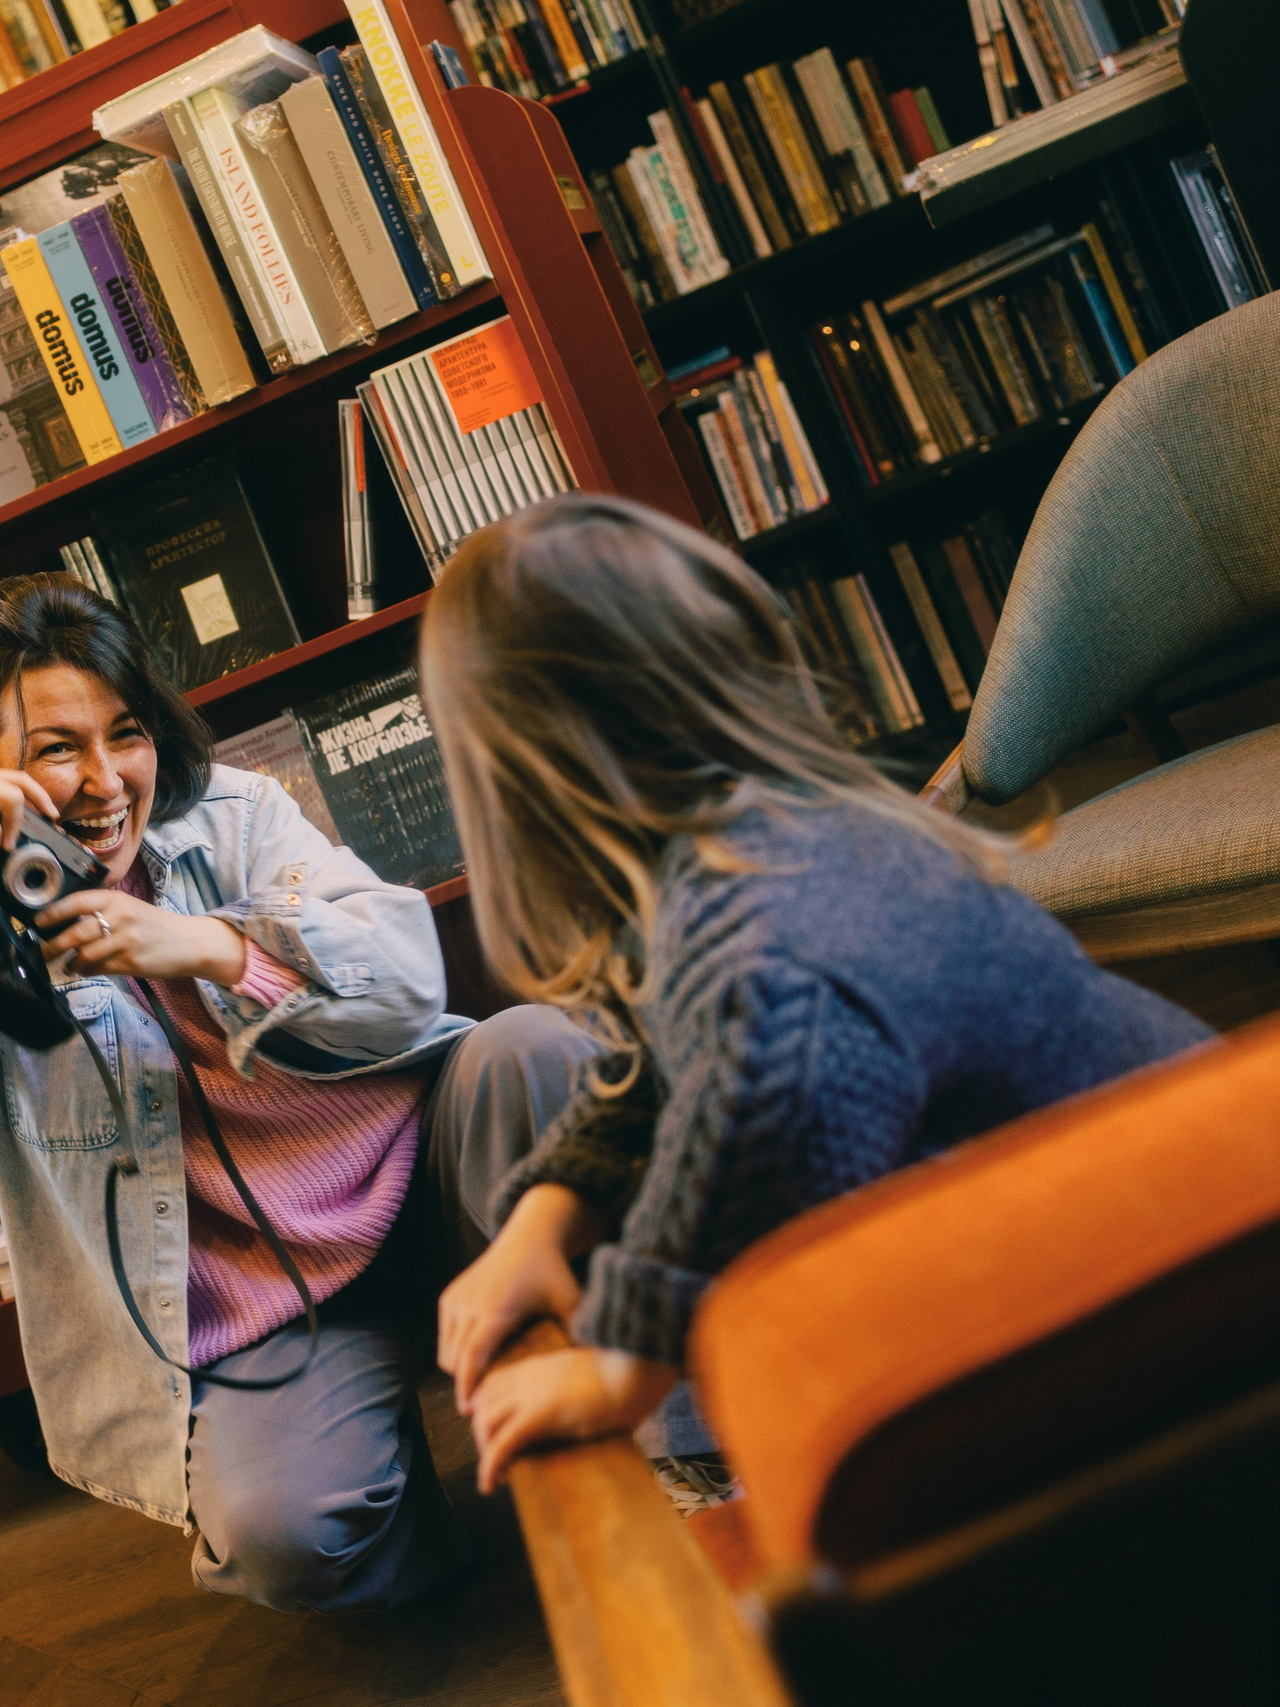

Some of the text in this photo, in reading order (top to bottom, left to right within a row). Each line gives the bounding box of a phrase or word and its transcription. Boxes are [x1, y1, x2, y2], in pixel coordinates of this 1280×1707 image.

[353, 5, 417, 121] KNOKKE
[185, 146, 201, 163] THE
[331, 73, 348, 101] BLUE
[345, 105, 359, 127] AND
[356, 131, 375, 165] WHITE
[385, 203, 405, 237] RIGHT
[380, 127, 405, 164] Design
[401, 121, 425, 149] LE
[191, 160, 210, 183] EDITH
[411, 149, 451, 214] ZOUTE
[199, 180, 228, 226] FARNSWORTH
[324, 149, 376, 255] CONTEMPORARY LIVING
[217, 146, 296, 305] ISLAND FOLLIES
[217, 223, 237, 248] HOUSE
[68, 290, 123, 382] domus
[104, 271, 160, 365] domus
[34, 306, 88, 397] domus
[437, 342, 487, 368] АРХИТЕКТУРА
[441, 353, 488, 378] СОВЕТСКОГО
[446, 361, 497, 389] МОДЕРНИЗМА
[144, 517, 221, 557] ПРОФЕССИЯ
[147, 529, 228, 571] АРХИТЕКТОР
[316, 713, 375, 754] ЖИЗНЬ
[324, 747, 350, 776] ЛЕ
[347, 714, 433, 766] КОРБЮЗЬЕ
